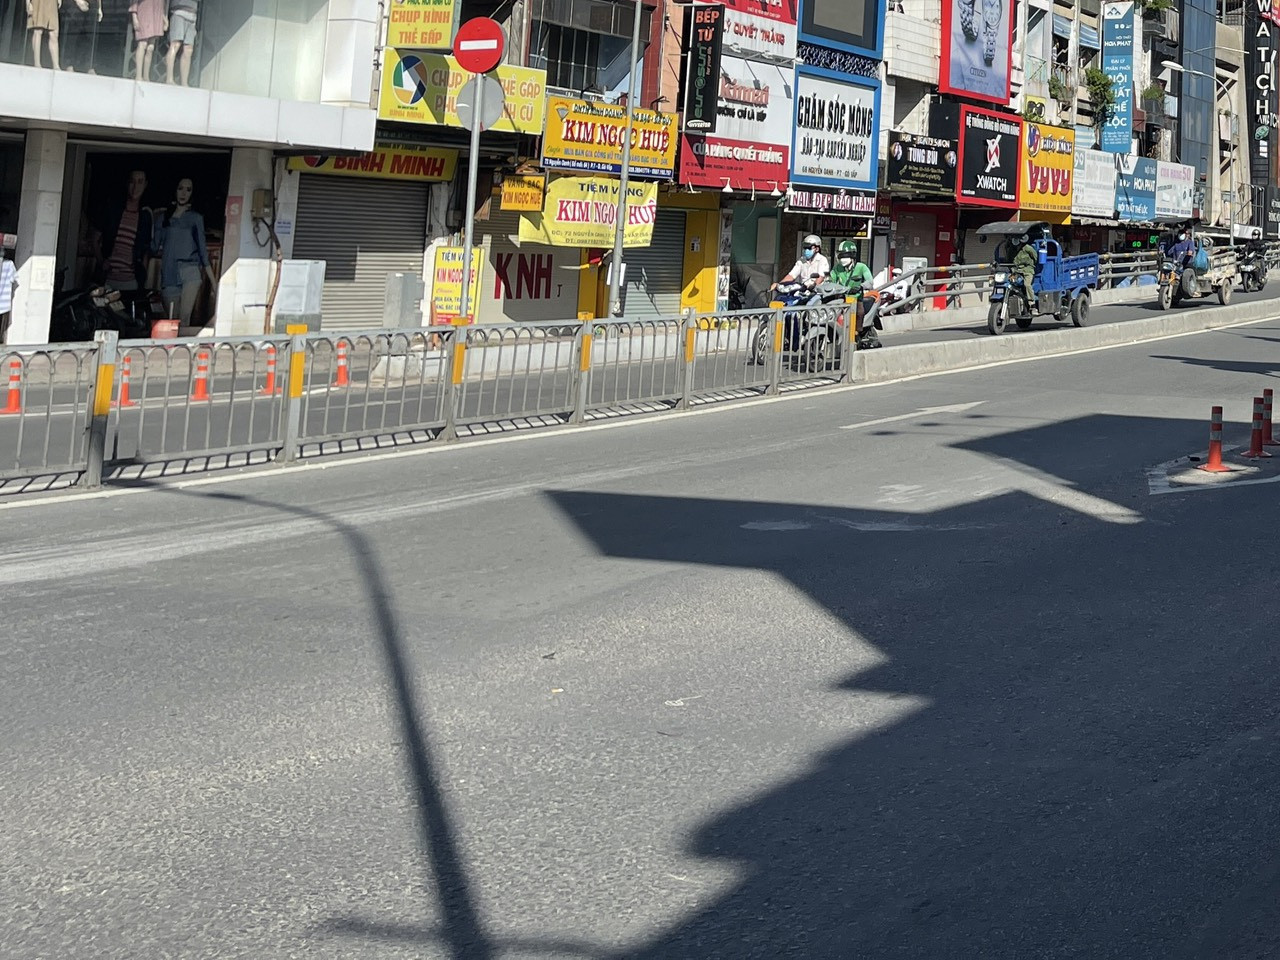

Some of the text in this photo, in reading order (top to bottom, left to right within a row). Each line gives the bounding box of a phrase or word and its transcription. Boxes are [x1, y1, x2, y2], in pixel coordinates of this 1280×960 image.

[391, 8, 450, 26] CHỤP HÌNH
[695, 7, 720, 23] BẾP
[399, 28, 442, 44] THẺ GẤP
[697, 26, 714, 41] TỪ
[733, 22, 758, 40] QUYẾT
[519, 76, 541, 98] GẤP
[1108, 73, 1127, 86] NỘI
[435, 95, 533, 122] PHỤ CŨ
[797, 93, 873, 138] CHĂM SÓC MÓNG
[1107, 117, 1127, 129] LỘC
[562, 119, 670, 157] KIM NGỌC HUỆ
[390, 154, 445, 176] MINH
[611, 186, 644, 197] VNG
[976, 175, 1007, 192] XWATCH
[502, 192, 541, 208] KIM NGỌC HUỆ
[792, 191, 812, 207] NAIL
[813, 193, 832, 211] ĐẸP
[556, 199, 591, 223] KIM
[441, 250, 456, 262] TIỆM
[494, 253, 553, 299] KNH
